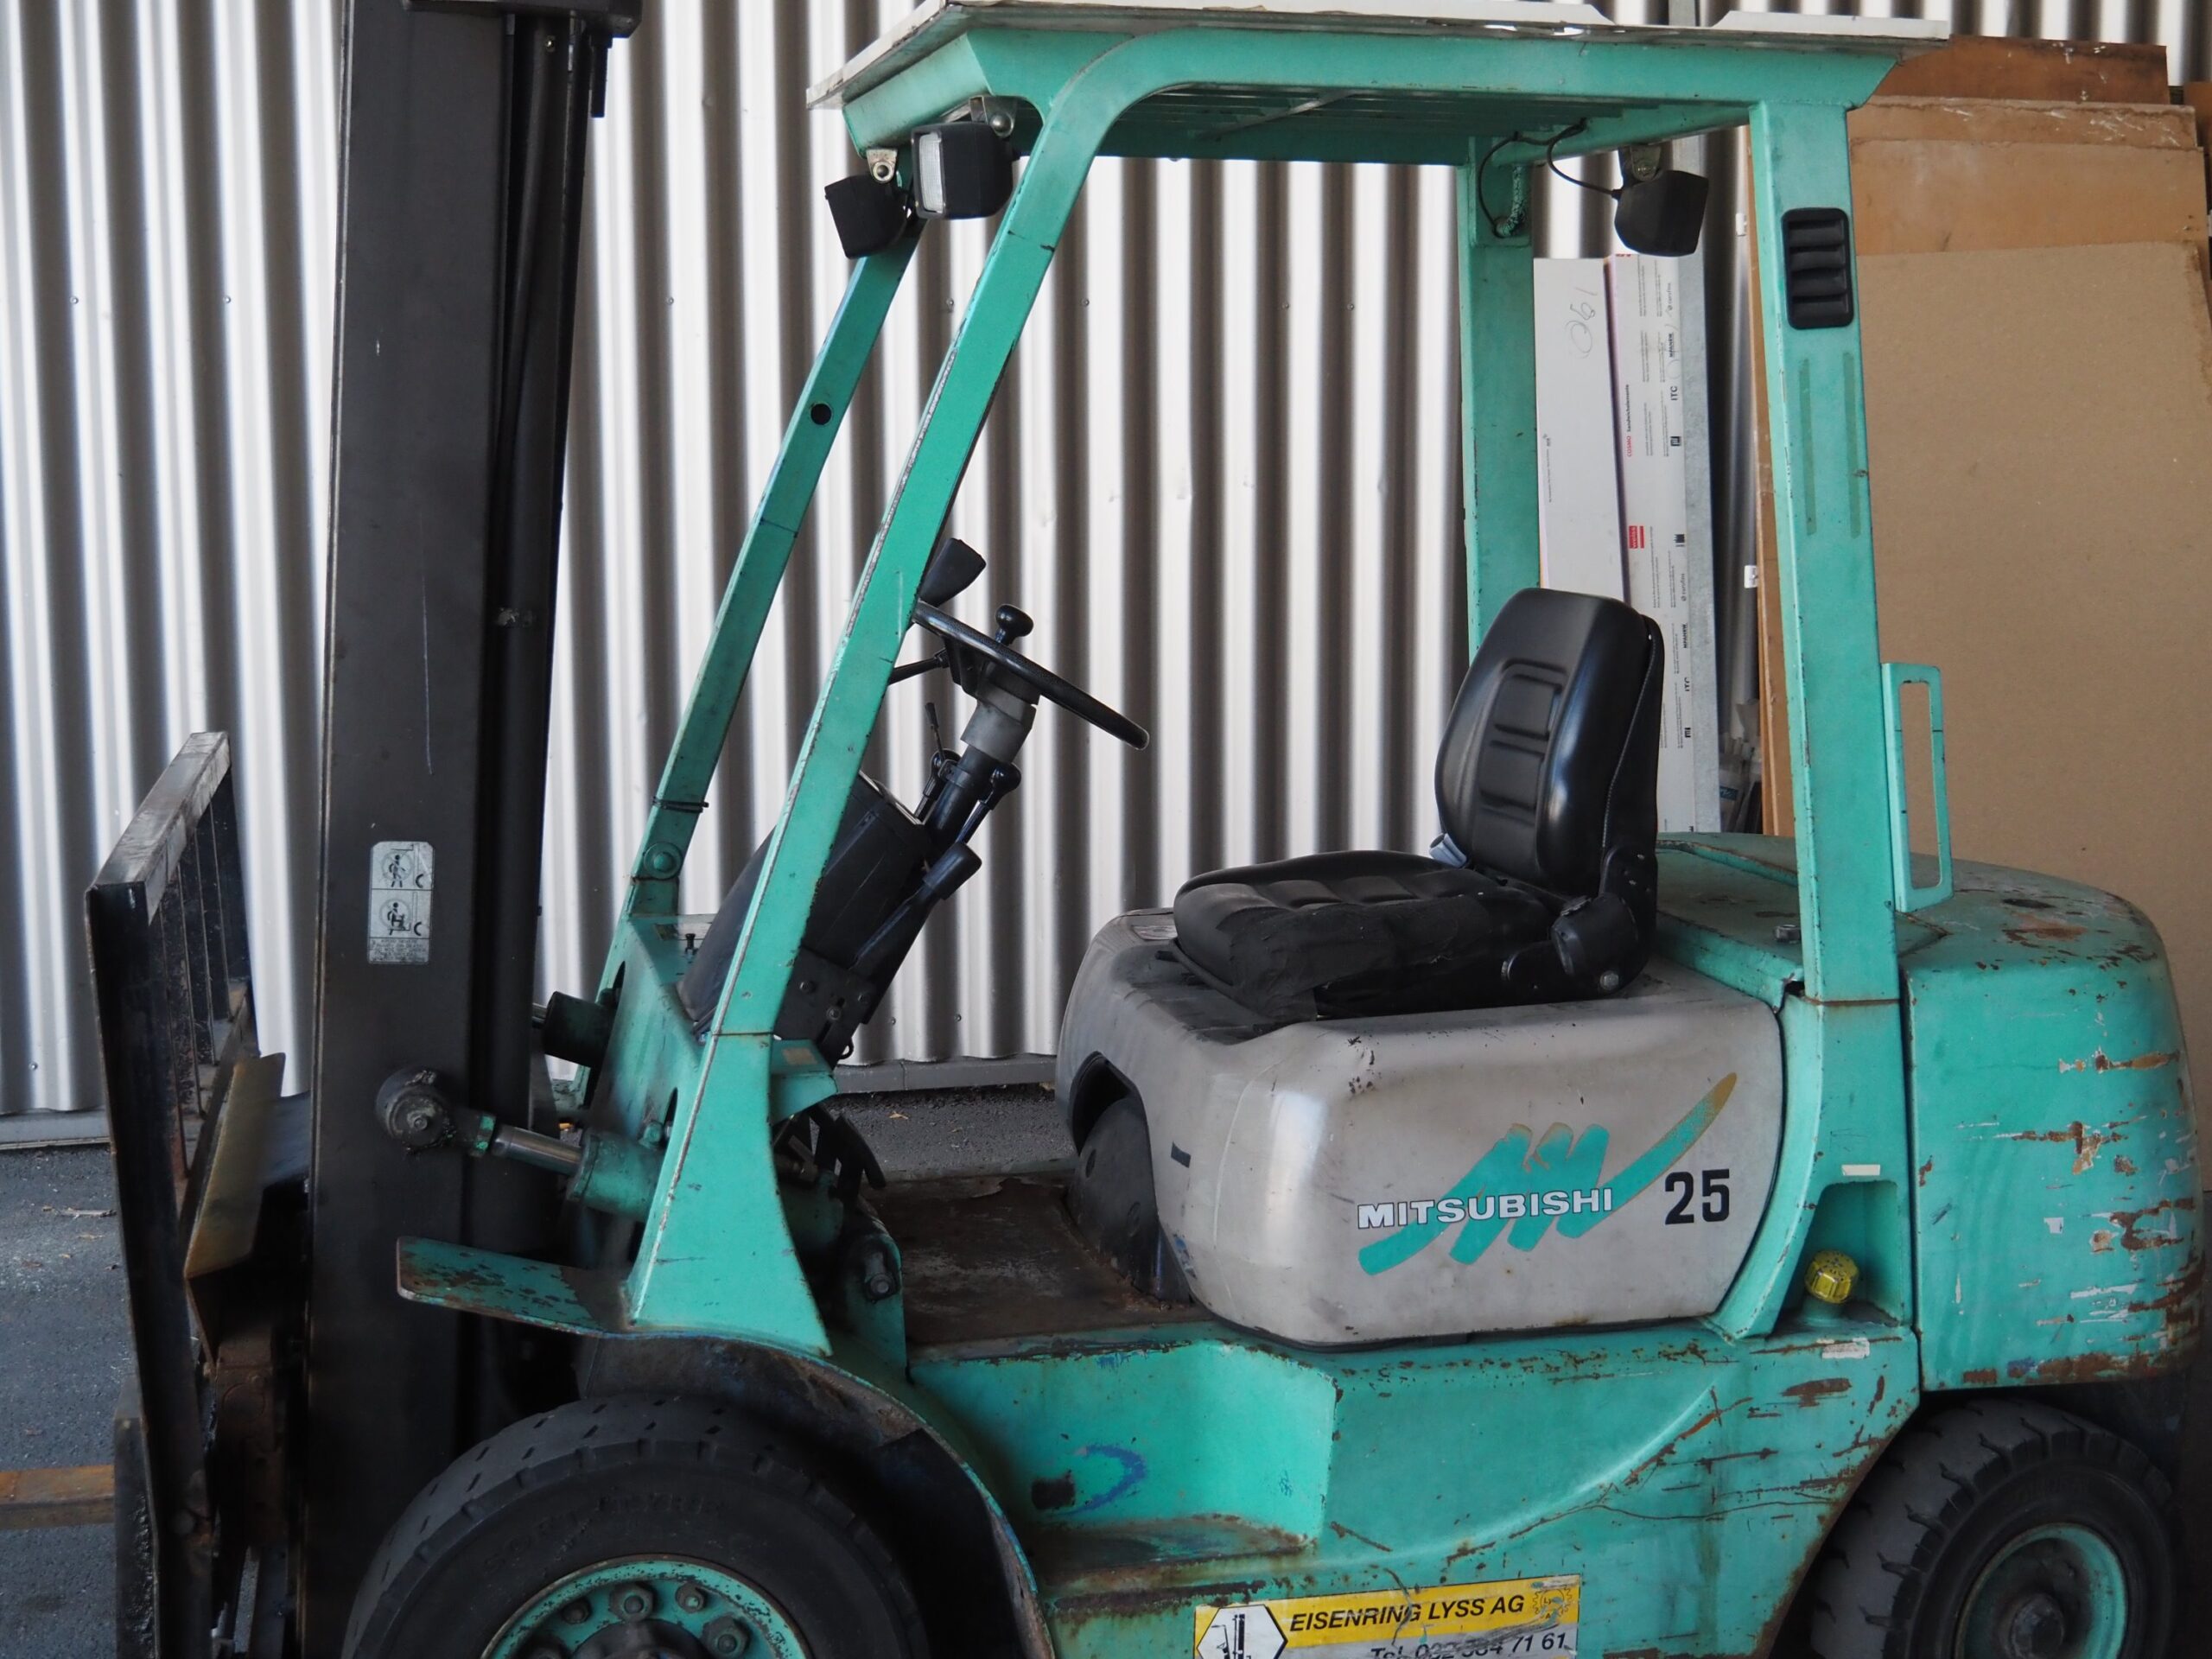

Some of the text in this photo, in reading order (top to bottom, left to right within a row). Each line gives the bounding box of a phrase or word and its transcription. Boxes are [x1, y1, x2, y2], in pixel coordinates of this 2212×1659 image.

[1669, 385, 1678, 401] ITC
[1356, 1187, 1613, 1229] MITSUBISHI
[1664, 1168, 1731, 1225] 25
[1290, 1604, 1421, 1632] EISENRING
[1427, 1598, 1484, 1620] LYSS
[1491, 1595, 1525, 1615] AG
[1542, 1632, 1566, 1651] 61
